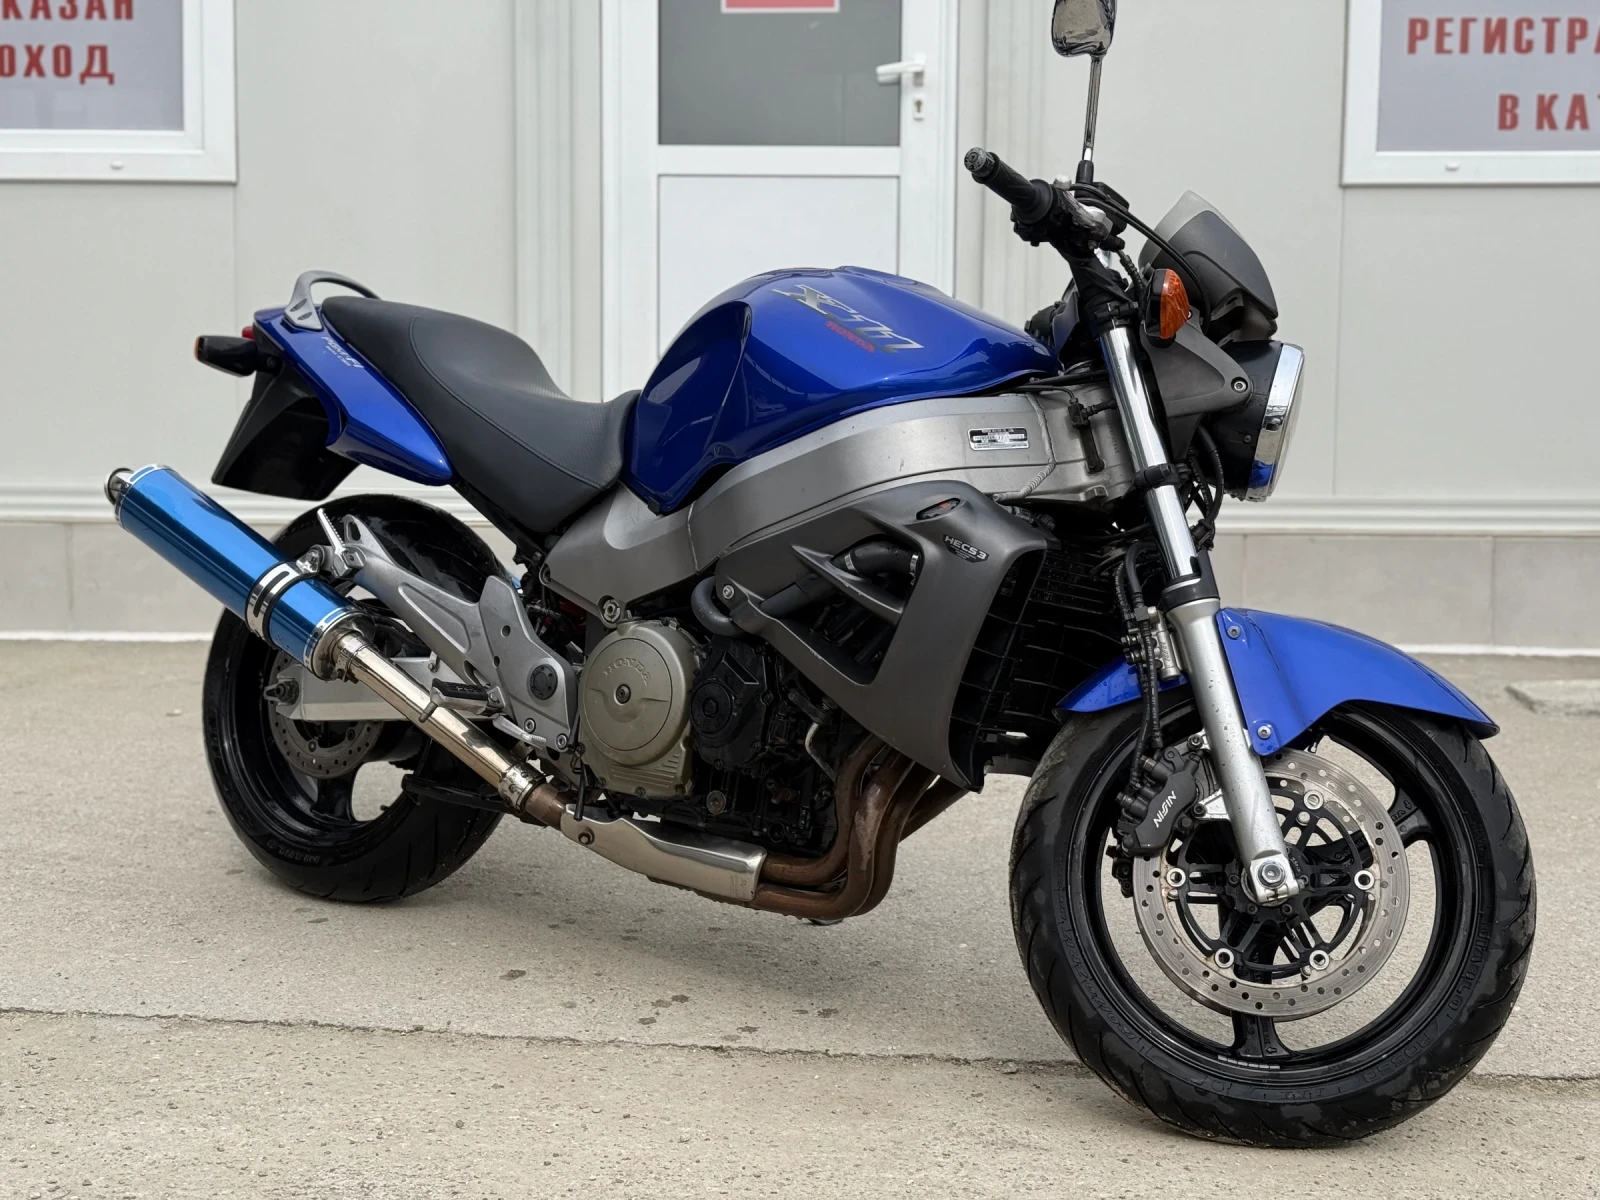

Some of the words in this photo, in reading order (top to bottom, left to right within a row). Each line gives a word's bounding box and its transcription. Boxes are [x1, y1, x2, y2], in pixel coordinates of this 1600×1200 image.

[1407, 17, 1600, 54] РЕГИСТР
[1497, 93, 1519, 131] В
[1535, 93, 1600, 131] КА
[1152, 790, 1177, 829] NISSIN
